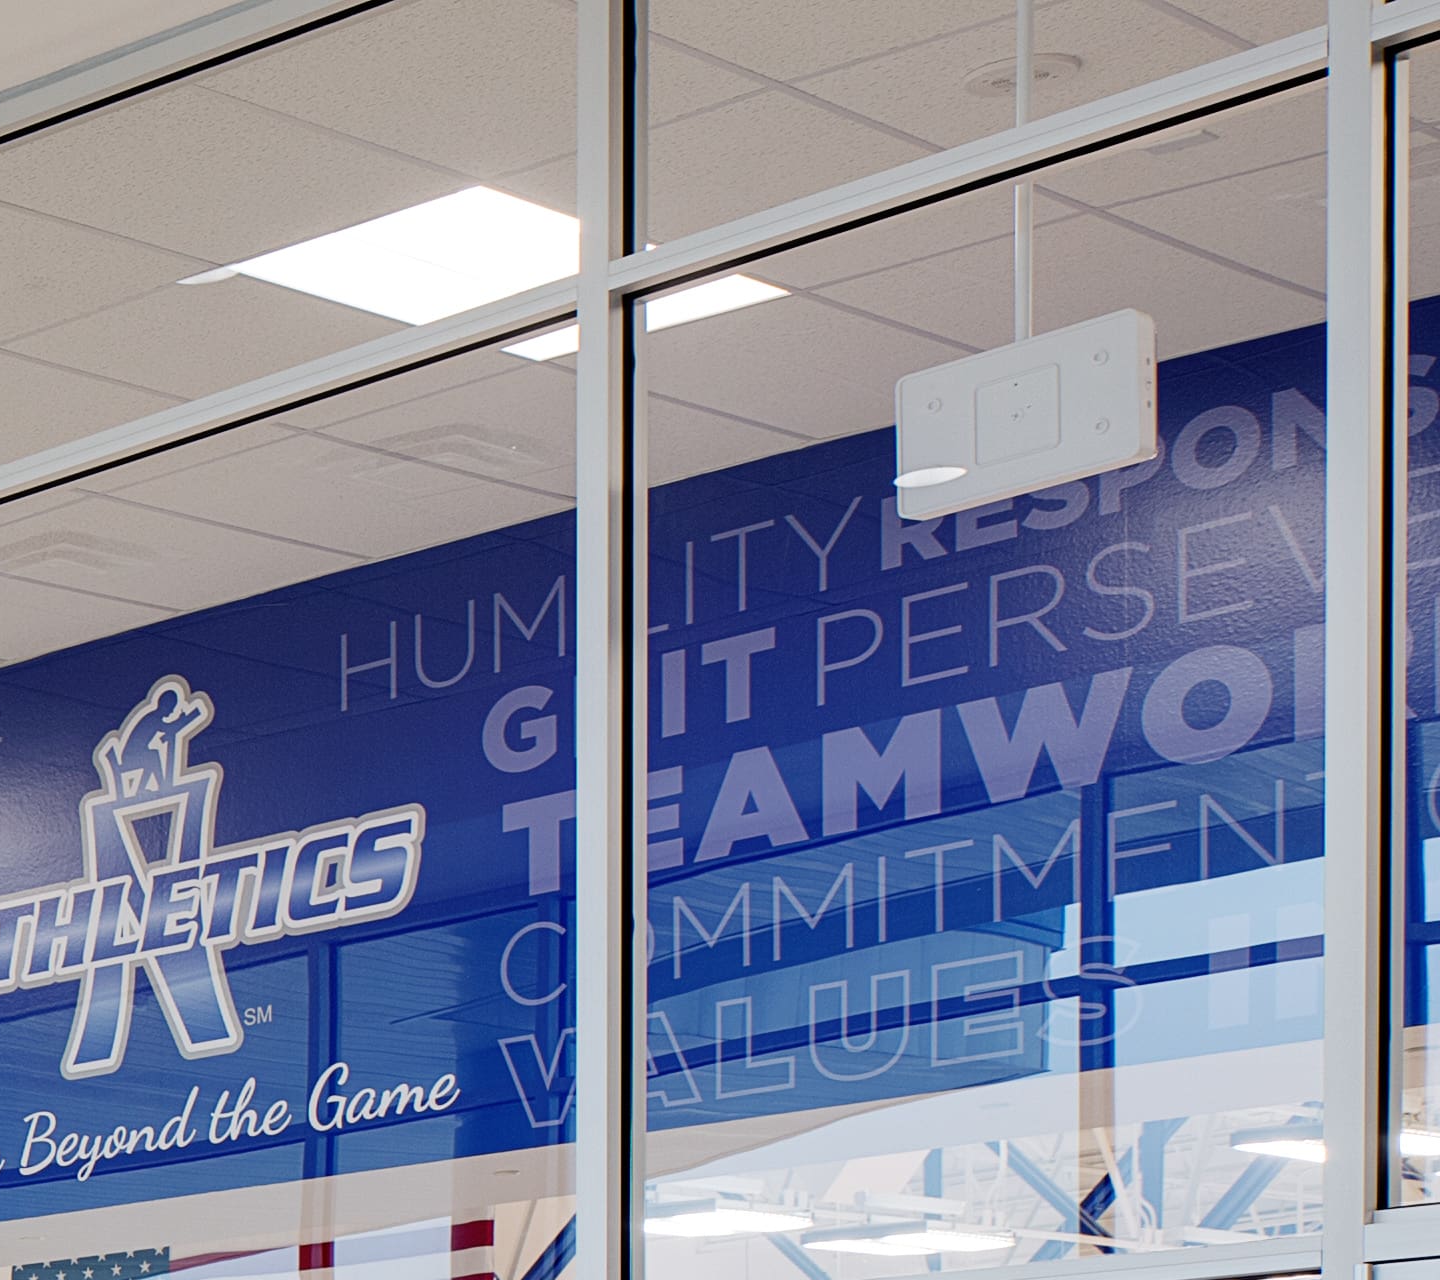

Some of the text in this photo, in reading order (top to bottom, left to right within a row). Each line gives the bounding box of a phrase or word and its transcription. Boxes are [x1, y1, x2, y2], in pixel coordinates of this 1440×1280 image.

[339, 495, 863, 712] HUMITY
[481, 628, 776, 773] GIT
[500, 772, 1325, 1006] CMMITMEN
[19, 1086, 196, 1181] Beyond
[208, 1078, 292, 1142] the
[308, 1062, 461, 1131] Game
